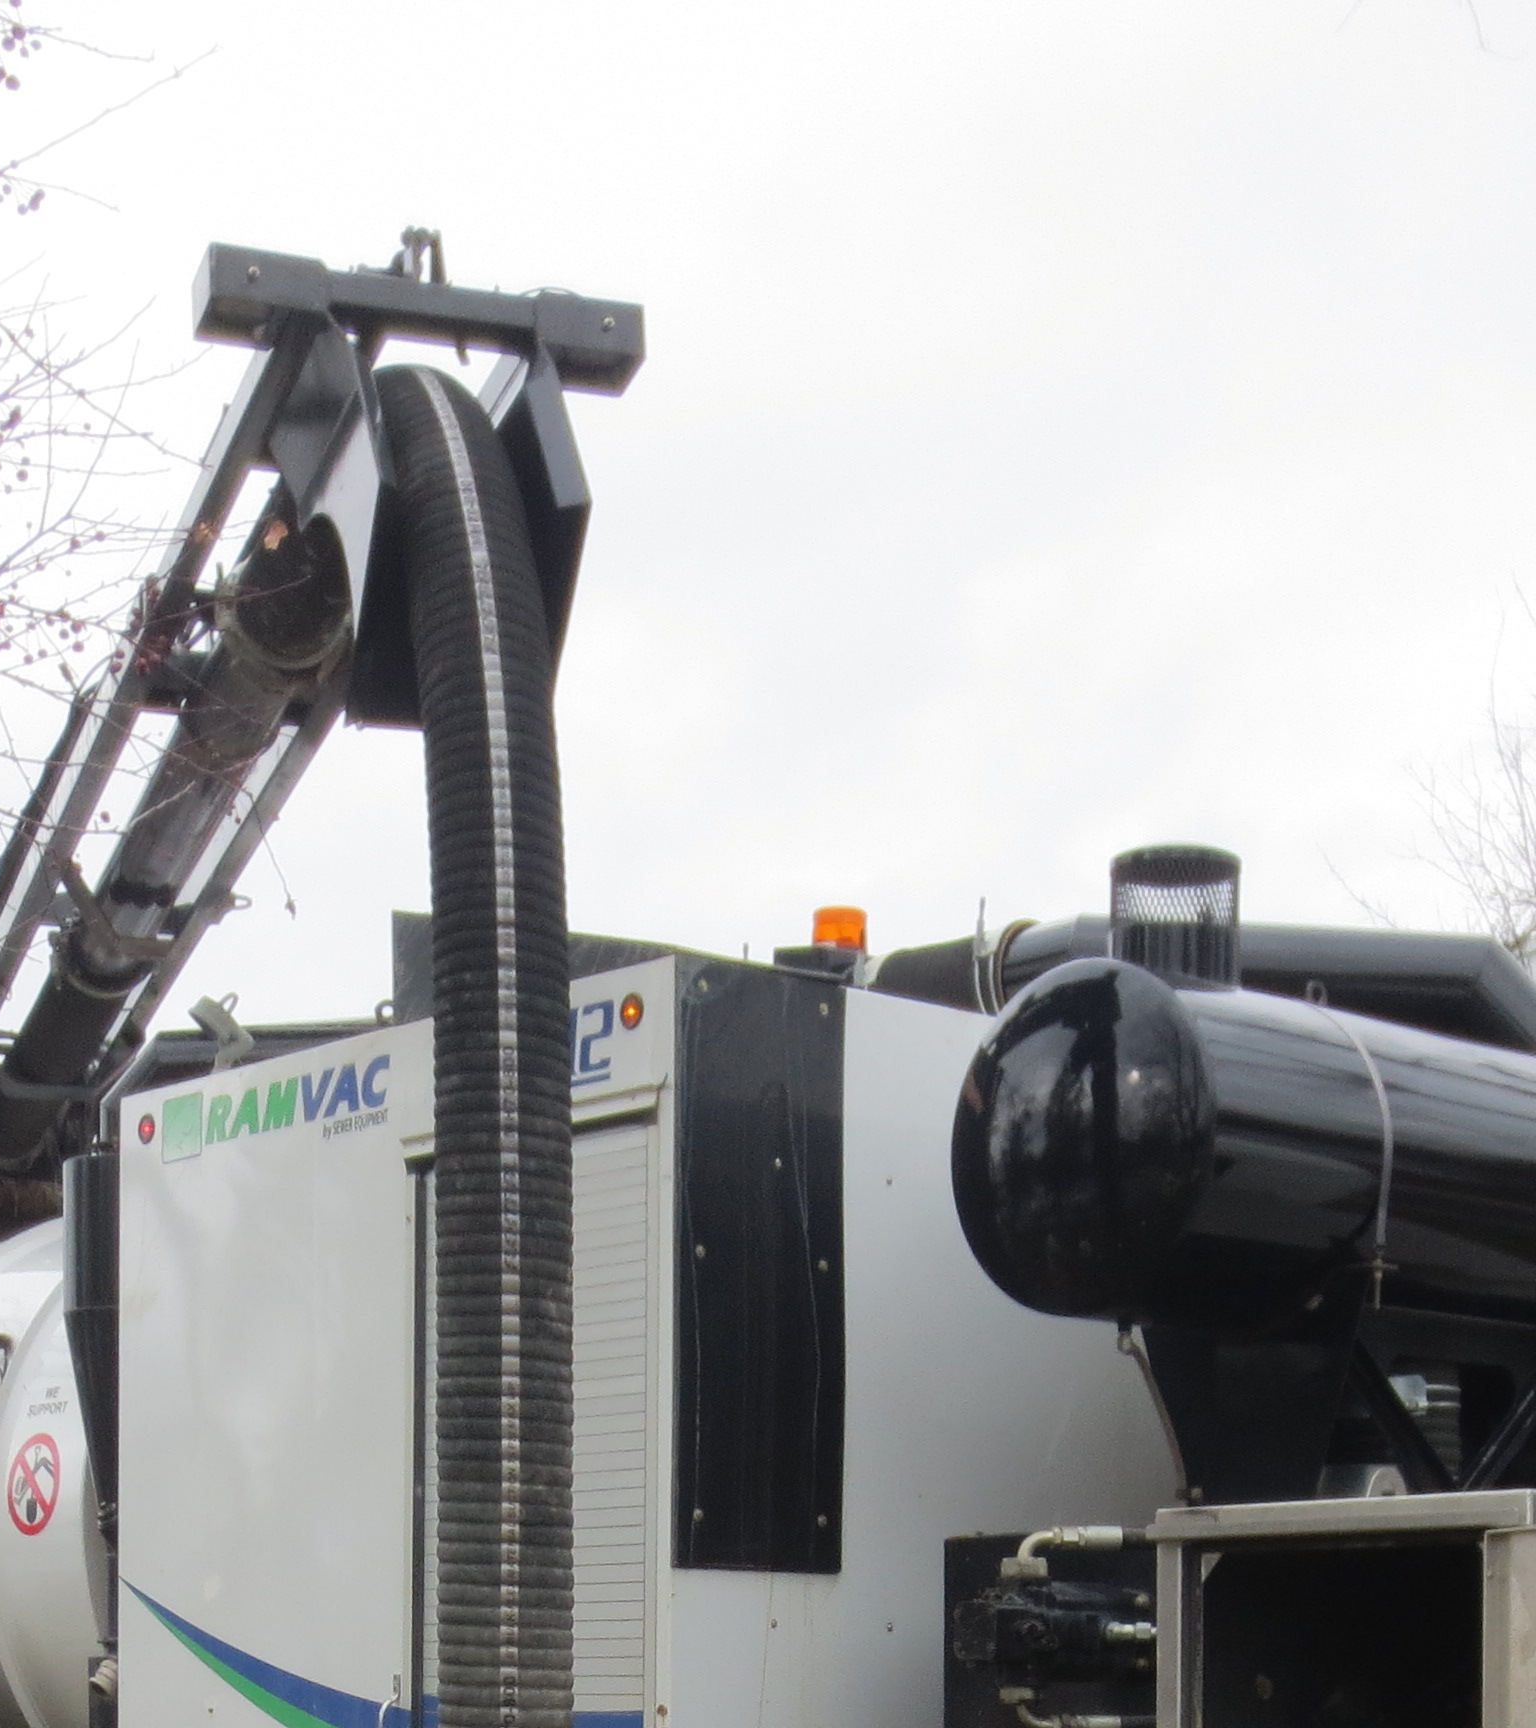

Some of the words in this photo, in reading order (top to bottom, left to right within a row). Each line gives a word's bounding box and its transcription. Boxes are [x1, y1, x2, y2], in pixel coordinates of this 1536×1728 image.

[204, 1054, 391, 1145] RAMVAC
[322, 1121, 332, 1140] by
[332, 1118, 353, 1135] SEWER
[354, 1108, 389, 1132] EQUIPMENT
[45, 1386, 61, 1399] WE
[27, 1400, 69, 1418] SUPPORT
